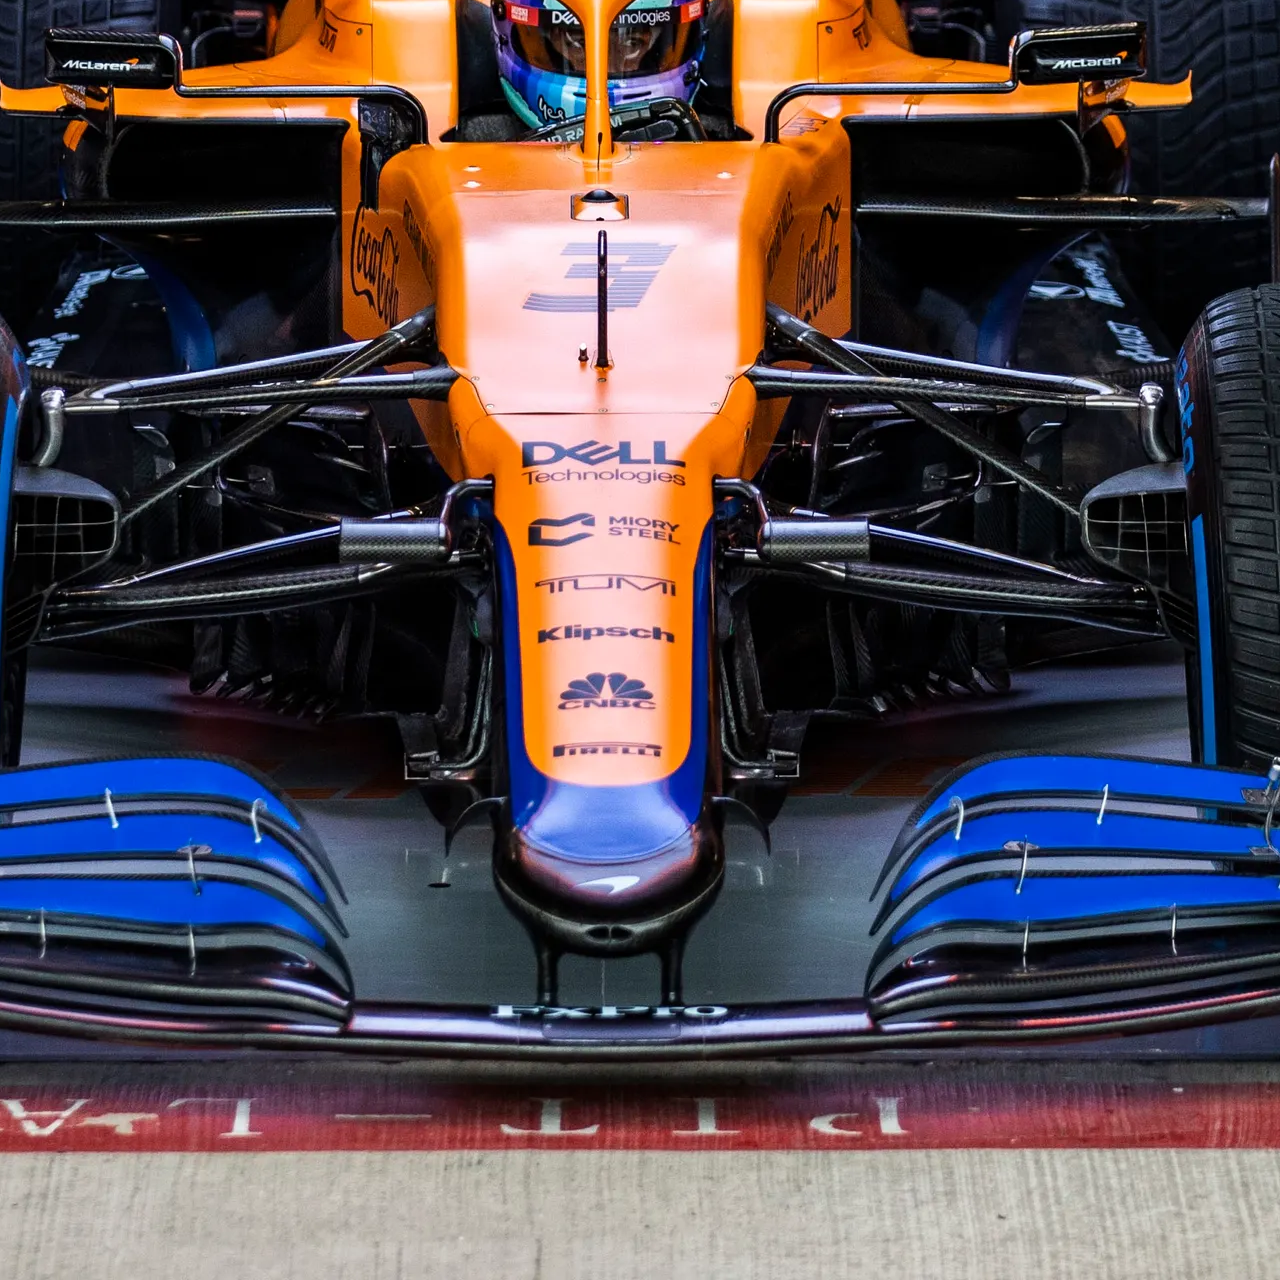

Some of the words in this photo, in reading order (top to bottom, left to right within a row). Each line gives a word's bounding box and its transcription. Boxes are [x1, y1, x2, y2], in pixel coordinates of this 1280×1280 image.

[61, 57, 125, 72] McLaren
[1051, 55, 1122, 72] McLaren
[522, 440, 686, 468] DELL
[522, 467, 686, 486] Technologies
[608, 515, 680, 532] MIORY
[608, 527, 682, 545] STEEL
[534, 573, 677, 597] TUMI
[536, 623, 676, 645] Klipsch
[556, 698, 657, 711] CNBC
[552, 741, 663, 758] PIRELLI
